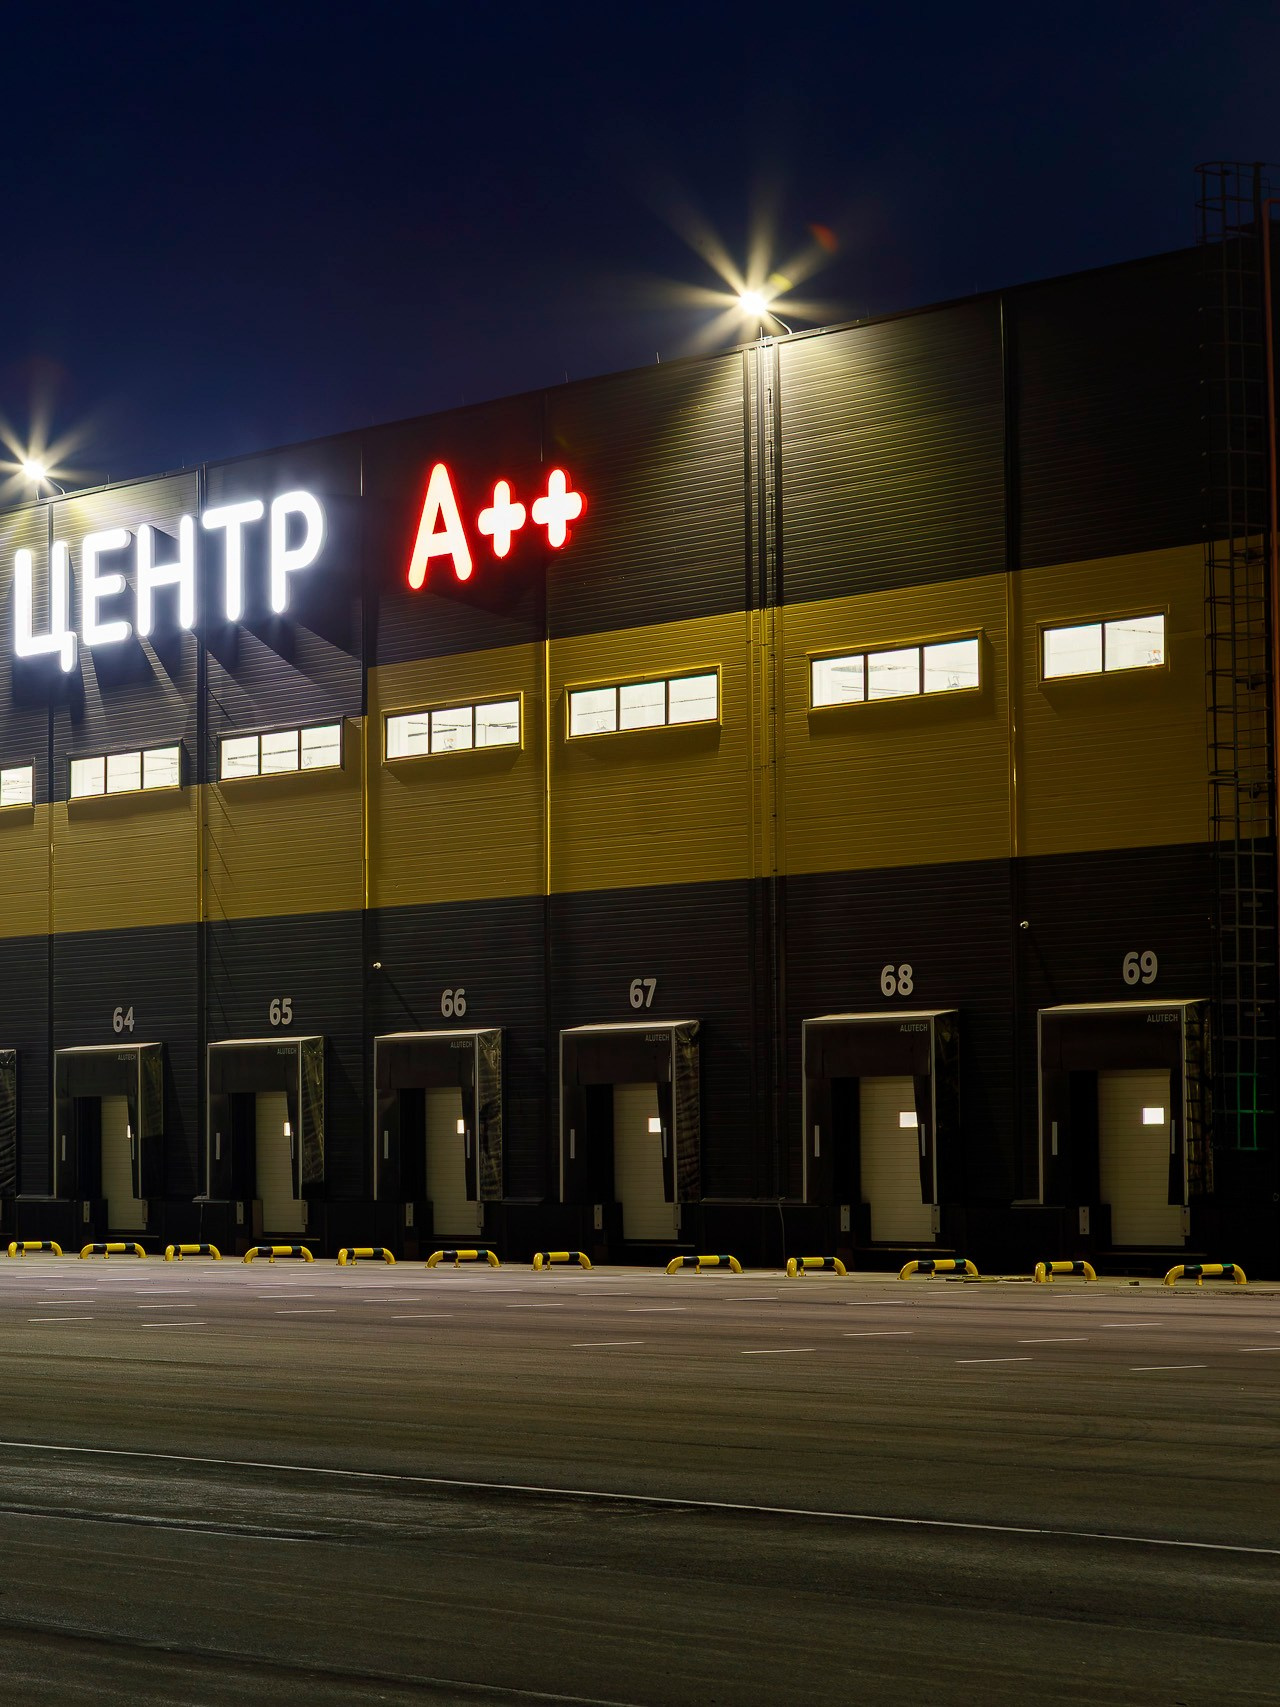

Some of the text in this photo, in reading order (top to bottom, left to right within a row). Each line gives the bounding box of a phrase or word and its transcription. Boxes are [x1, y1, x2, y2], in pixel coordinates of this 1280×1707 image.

[12, 490, 326, 673] ЦЕНТР
[880, 964, 914, 997] 68
[1122, 950, 1158, 986] 69
[440, 988, 467, 1018] 66
[629, 978, 657, 1008] 67
[112, 1006, 135, 1033] 64
[269, 998, 293, 1026] 65
[1146, 1013, 1178, 1024] ALUTECH
[645, 1032, 670, 1041] ALUTECH
[899, 1023, 928, 1032] ALUTECH
[117, 1053, 136, 1061] ALUTECH
[276, 1047, 297, 1055] ALUTECH
[450, 1040, 473, 1049] ALUTECH
